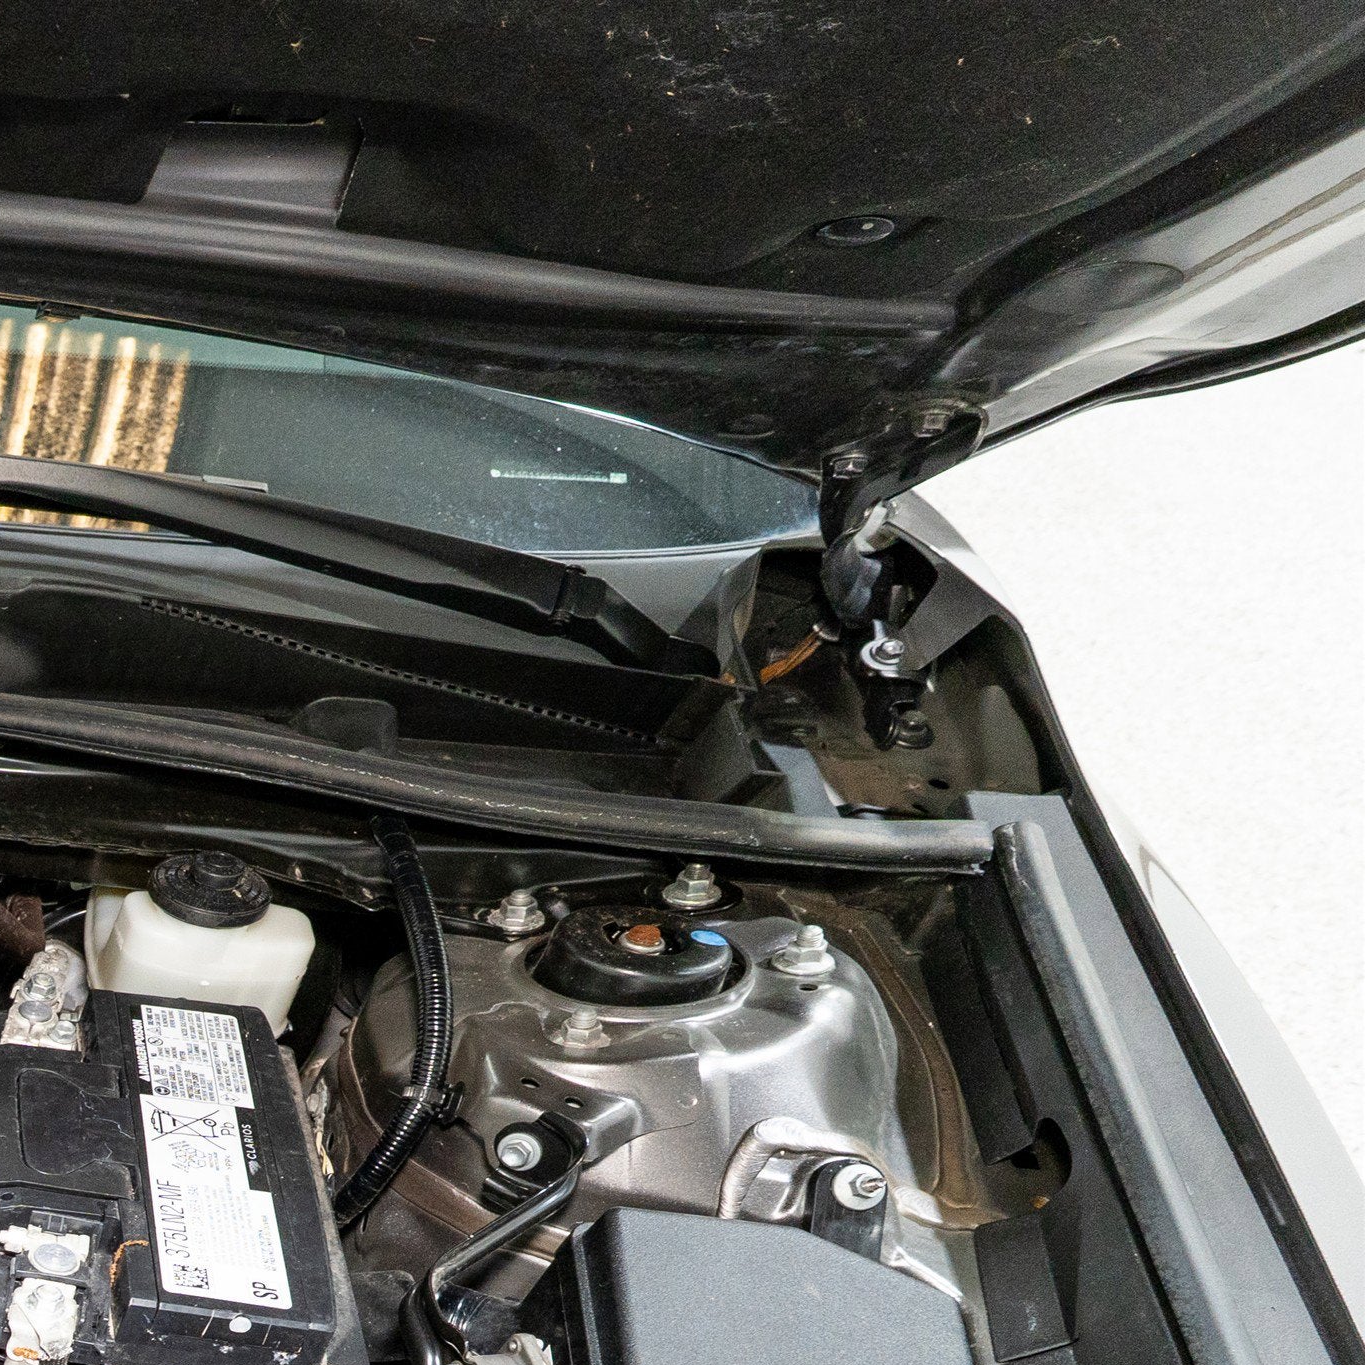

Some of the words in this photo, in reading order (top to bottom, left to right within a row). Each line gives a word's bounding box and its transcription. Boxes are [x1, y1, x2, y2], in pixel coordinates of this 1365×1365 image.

[221, 1121, 236, 1136] Pb
[241, 1123, 257, 1160] CLARIOS
[156, 1179, 190, 1258] 375LN2-MF
[252, 1281, 279, 1300] SP
